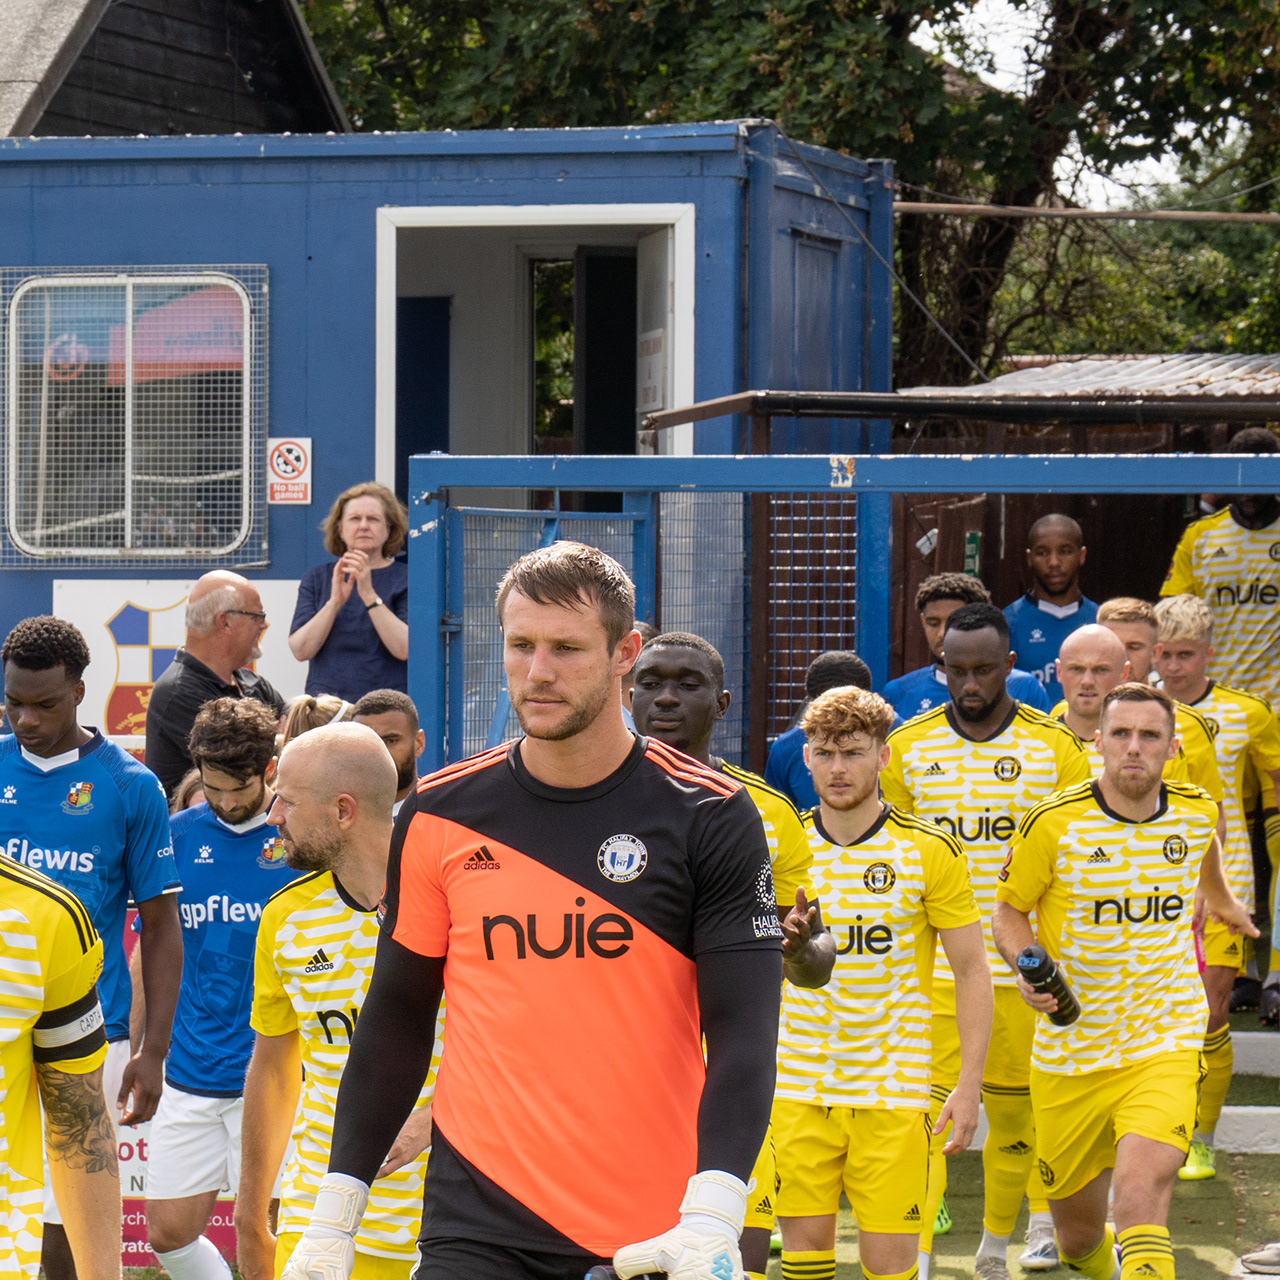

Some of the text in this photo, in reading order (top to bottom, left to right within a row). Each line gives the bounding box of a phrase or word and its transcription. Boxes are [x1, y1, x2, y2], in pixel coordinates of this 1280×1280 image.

[273, 483, 305, 492] No ball
[274, 491, 304, 500] games
[1216, 577, 1279, 606] nuie
[463, 860, 501, 871] adidas
[1094, 885, 1184, 925] nuie
[482, 896, 634, 961] nuie
[304, 960, 335, 975] adidas
